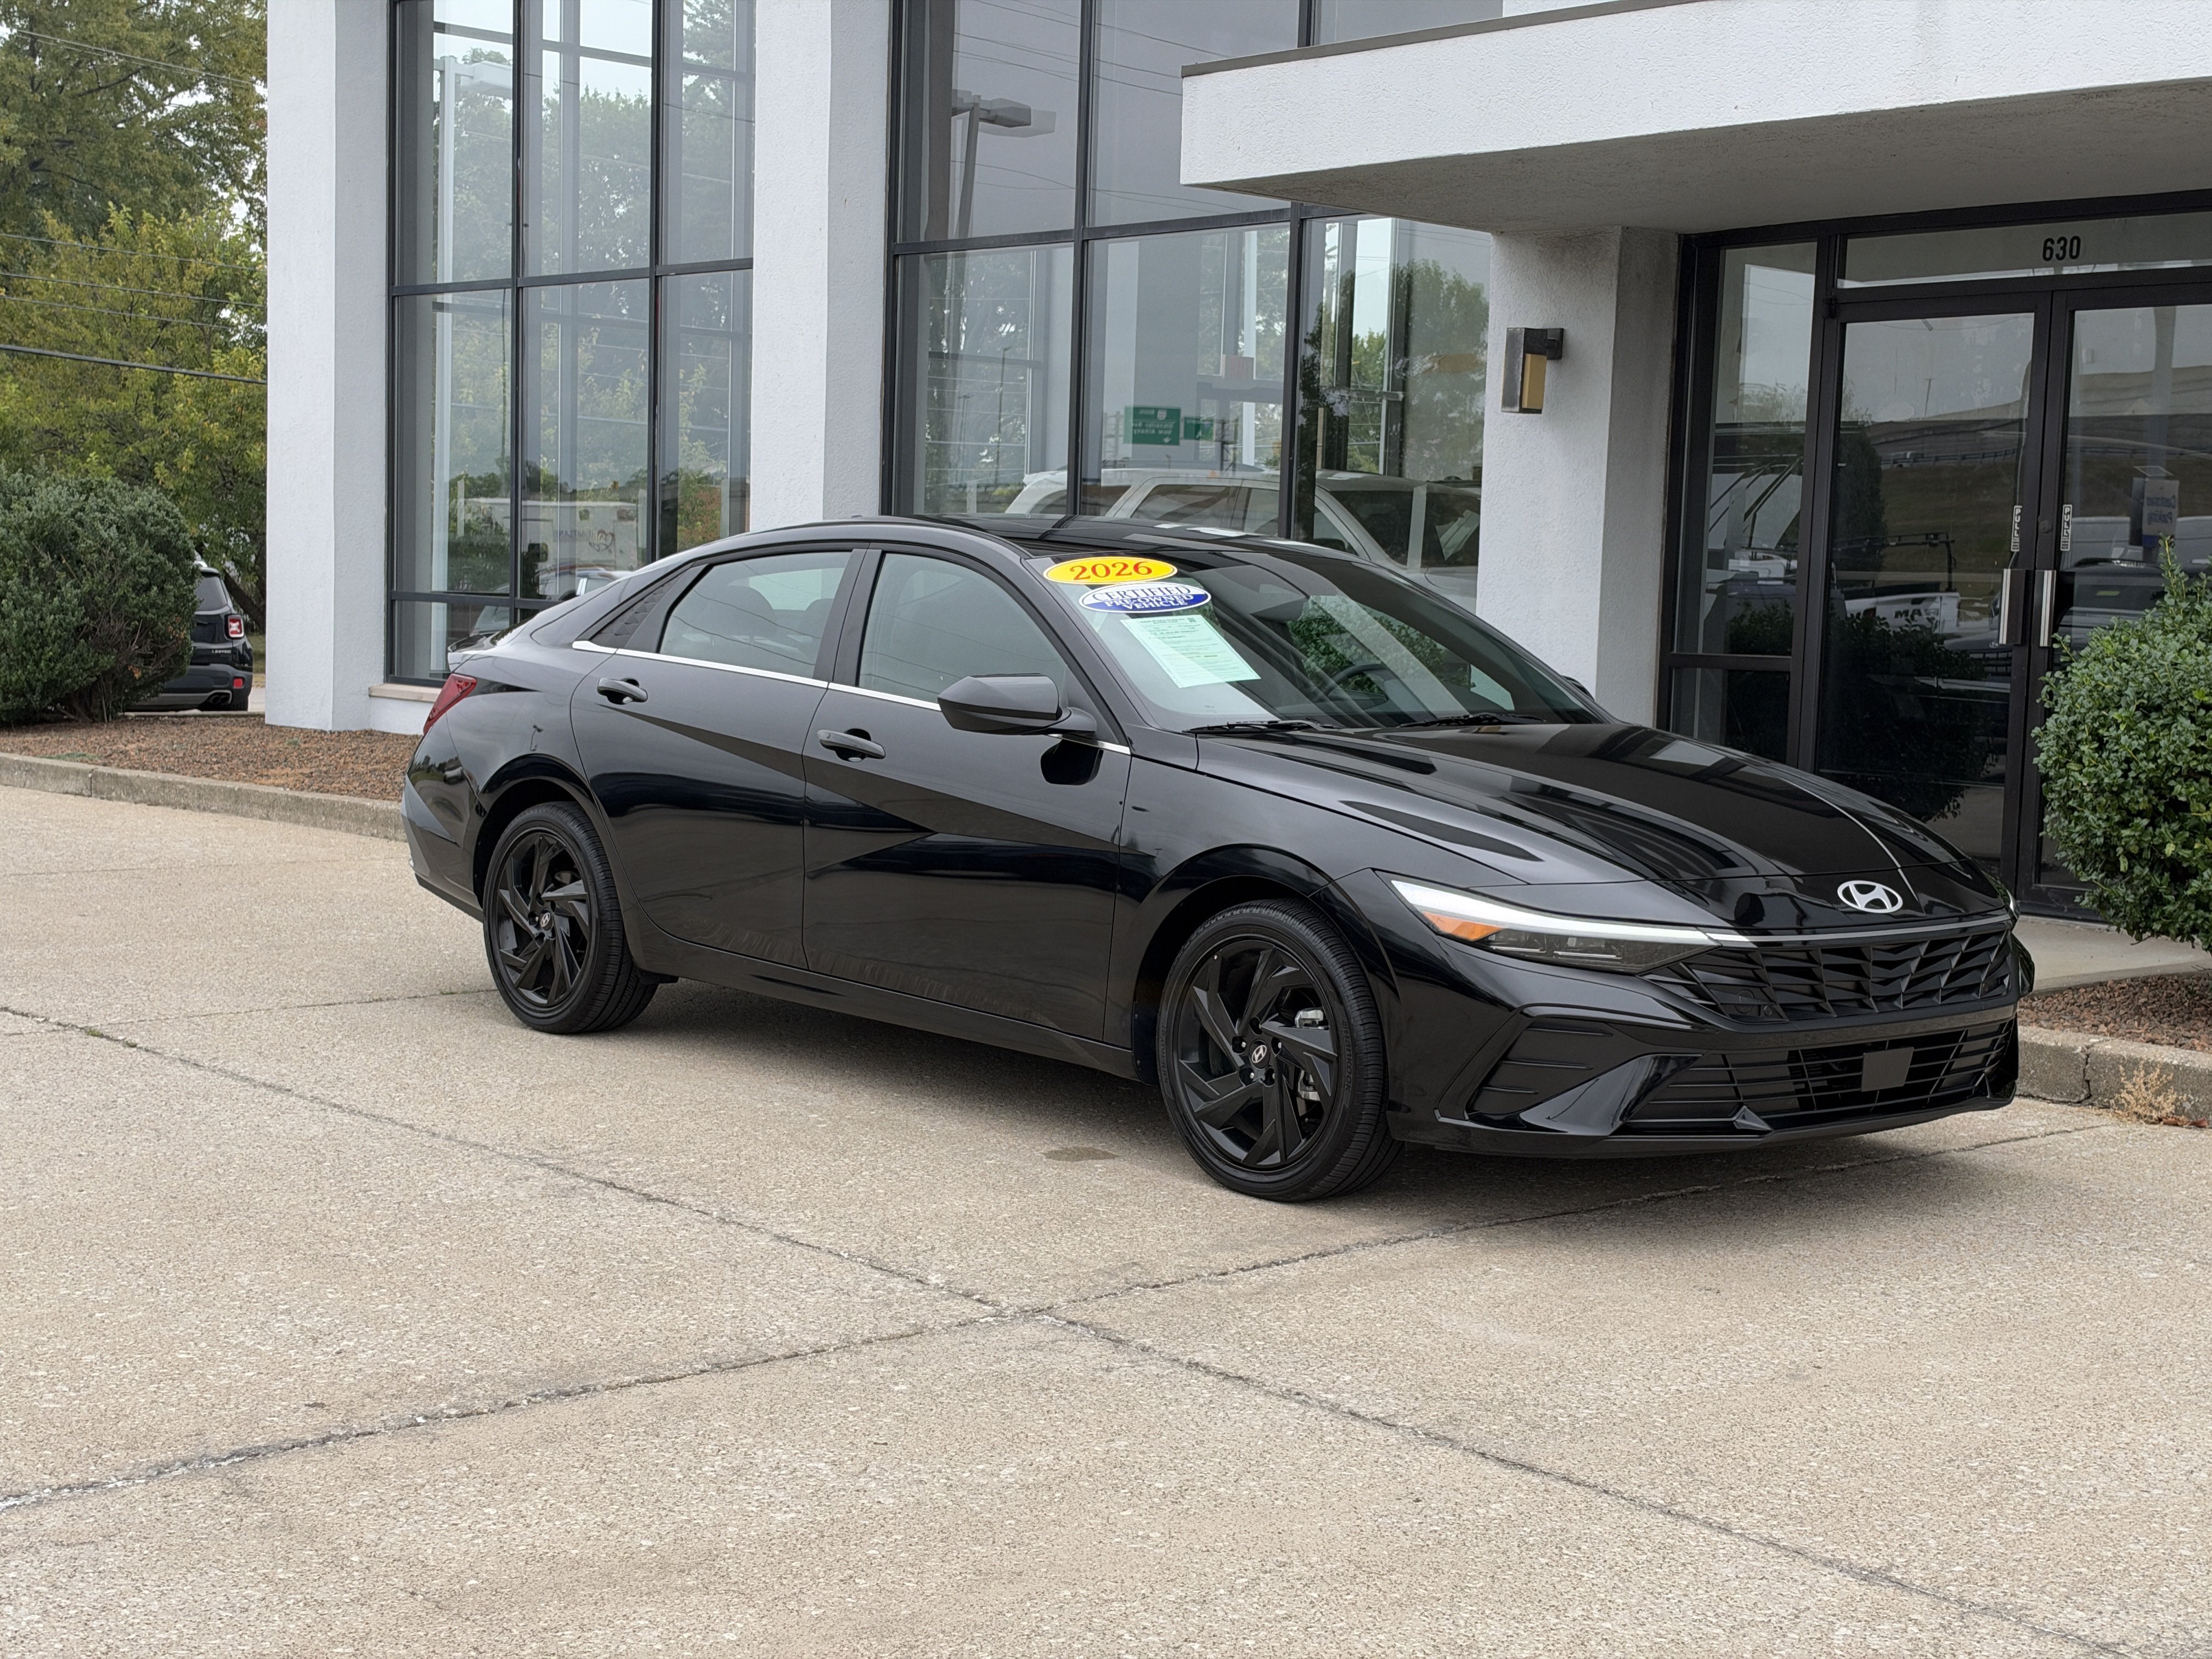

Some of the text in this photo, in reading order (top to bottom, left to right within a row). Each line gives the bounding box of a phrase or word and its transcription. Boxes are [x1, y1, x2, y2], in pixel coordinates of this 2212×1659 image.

[2042, 236, 2081, 262] 630
[1070, 561, 1152, 580] 2026
[1092, 586, 1190, 601] CERTIFIED
[1104, 594, 1194, 607] PRE-OWNED
[1122, 600, 1188, 610] VEHICLE
